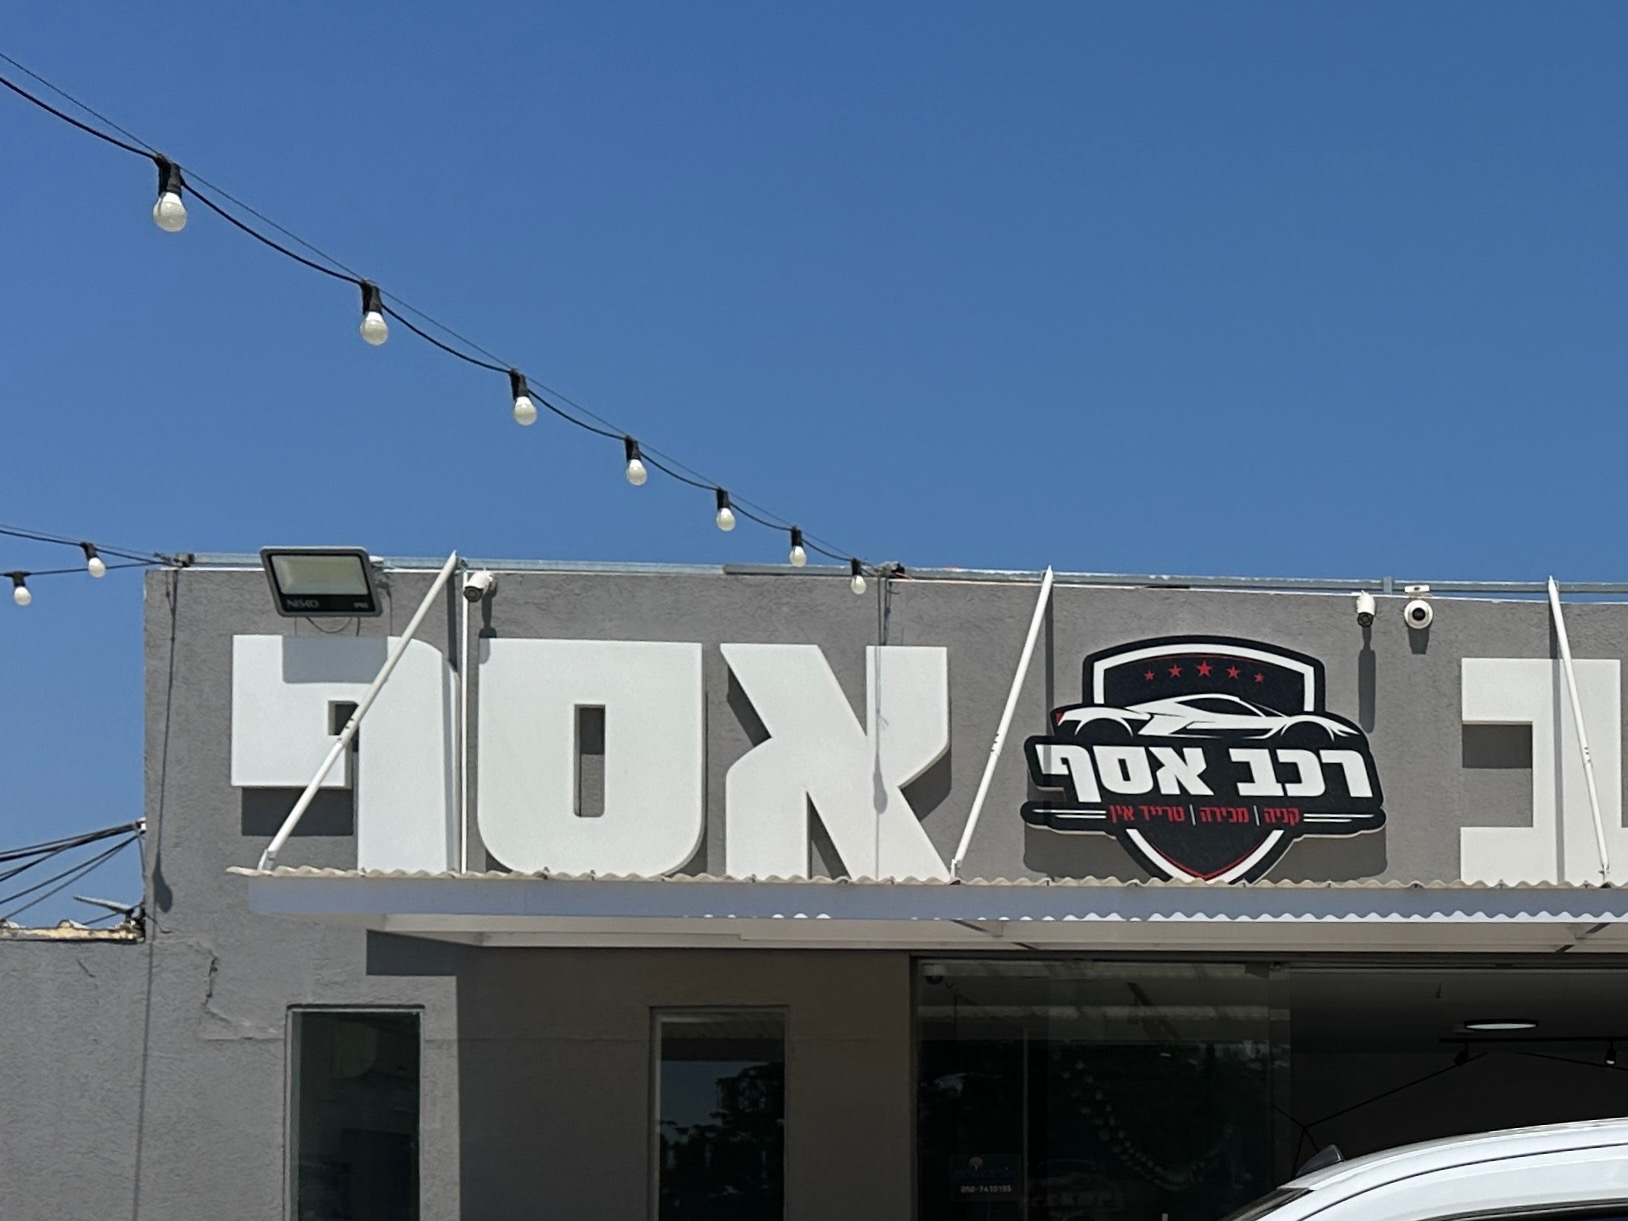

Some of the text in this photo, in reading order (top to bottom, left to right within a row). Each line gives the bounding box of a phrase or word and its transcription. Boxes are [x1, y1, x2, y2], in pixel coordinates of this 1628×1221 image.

[231, 634, 951, 881] אסף
[1035, 743, 1374, 802] רכב אסף
[1109, 804, 1300, 826] קניה מכירה טרייד אין
